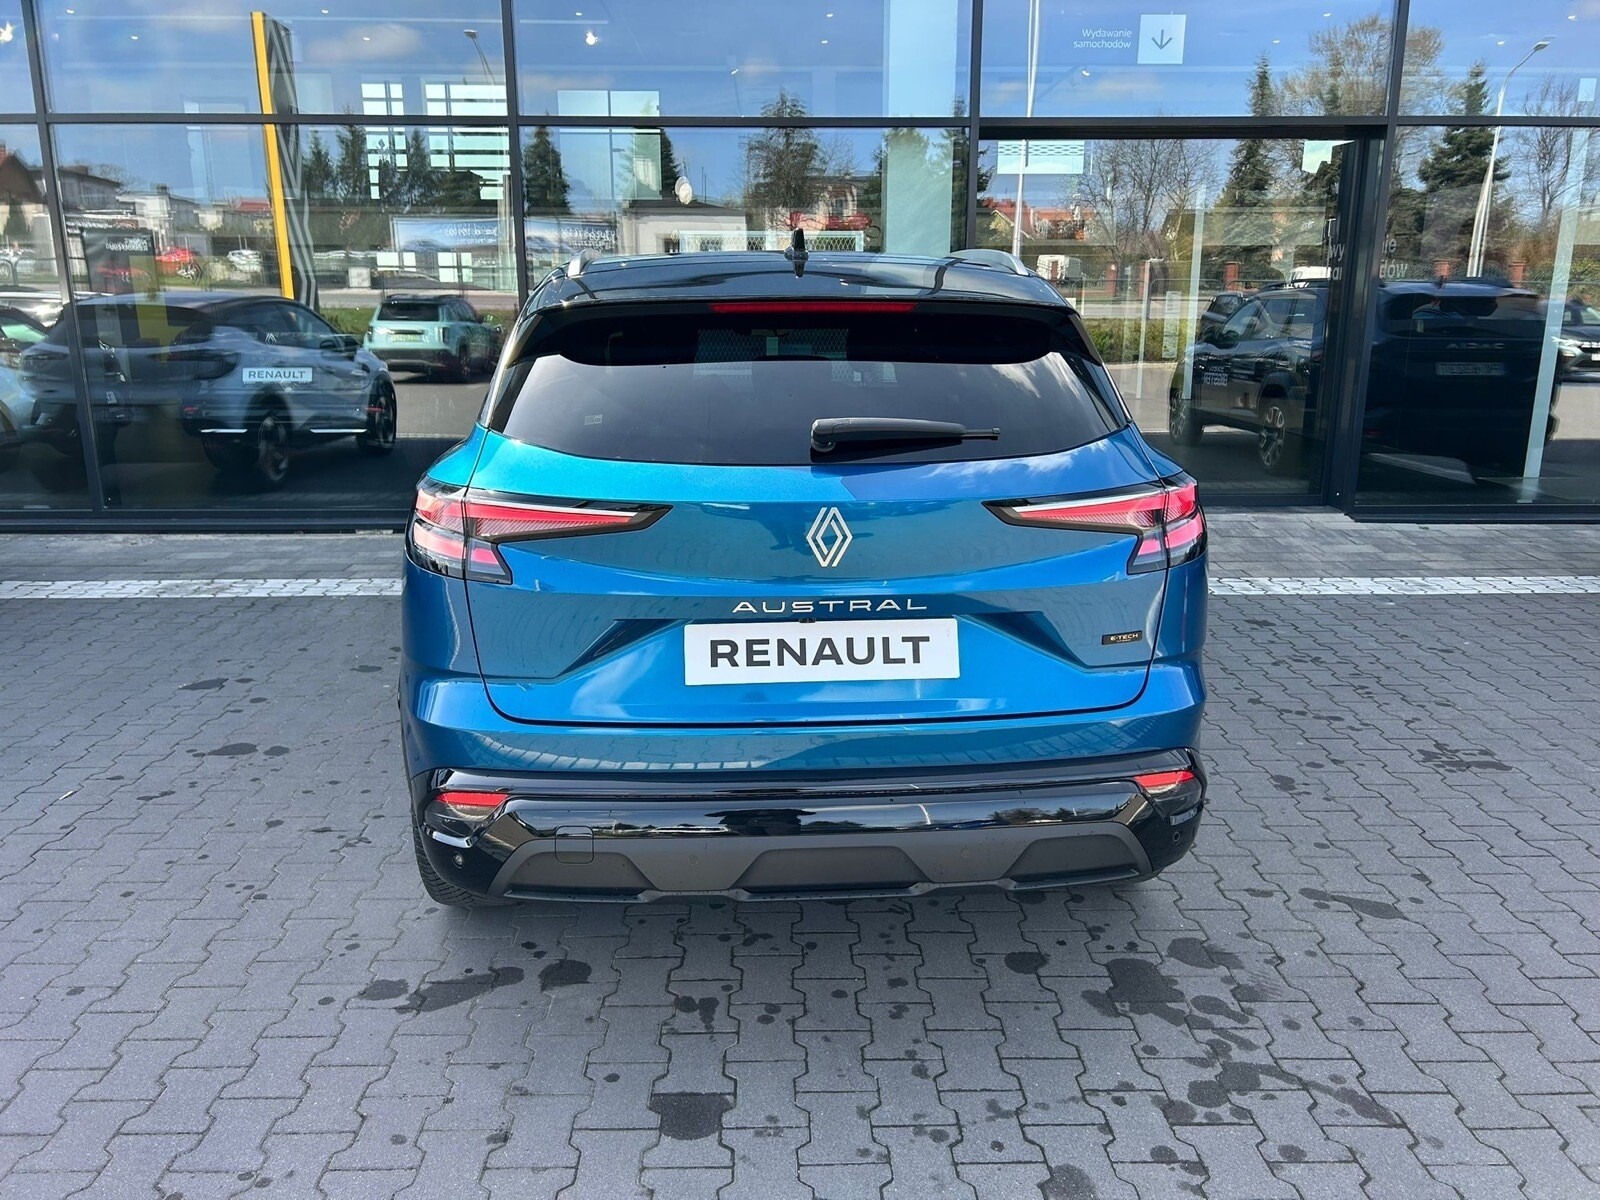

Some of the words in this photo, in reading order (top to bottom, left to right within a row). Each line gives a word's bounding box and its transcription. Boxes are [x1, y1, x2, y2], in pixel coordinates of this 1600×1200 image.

[1081, 28, 1132, 39] Wydawanie
[1073, 39, 1132, 49] samochodów
[248, 370, 306, 379] RENAULT
[732, 598, 928, 614] AUSTRAL
[1110, 633, 1139, 641] E-TECH
[709, 636, 931, 668] RENAULT
